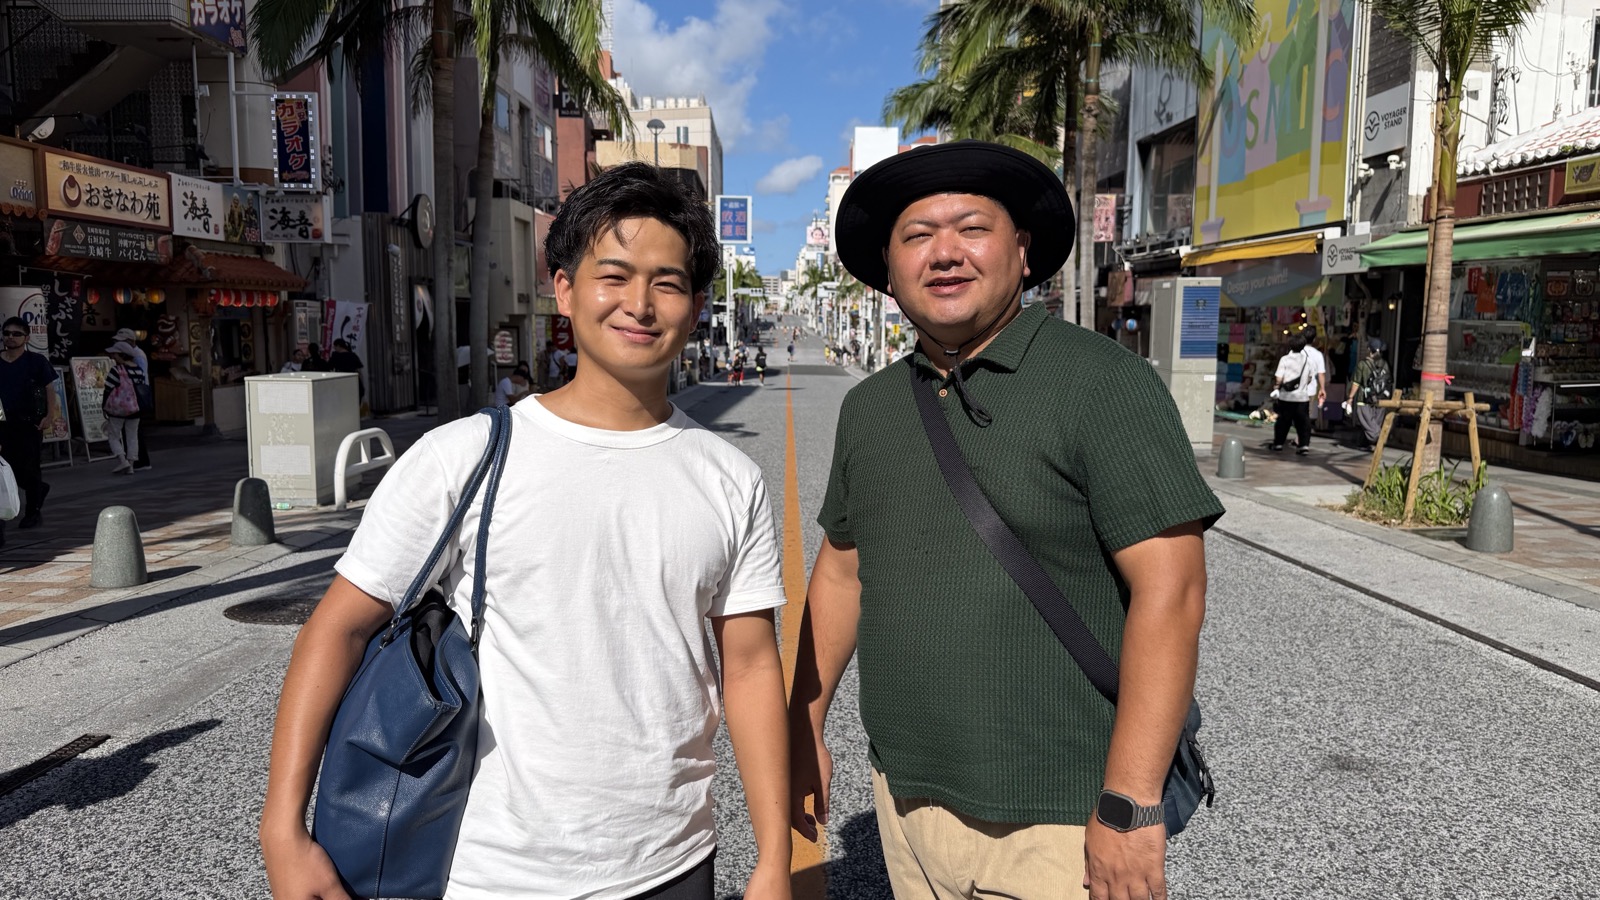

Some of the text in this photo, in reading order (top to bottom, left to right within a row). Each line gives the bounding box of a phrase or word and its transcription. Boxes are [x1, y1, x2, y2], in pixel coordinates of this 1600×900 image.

[191, 0, 243, 26] カラオケ
[1381, 107, 1407, 123] VOYAGER
[1384, 117, 1403, 130] STAND
[278, 102, 306, 170] カラオケ
[85, 182, 161, 220] おきなわ苑
[182, 190, 213, 234] 海音
[269, 206, 314, 239] 海音
[1227, 281, 1249, 295] Design
[1249, 277, 1267, 294] your
